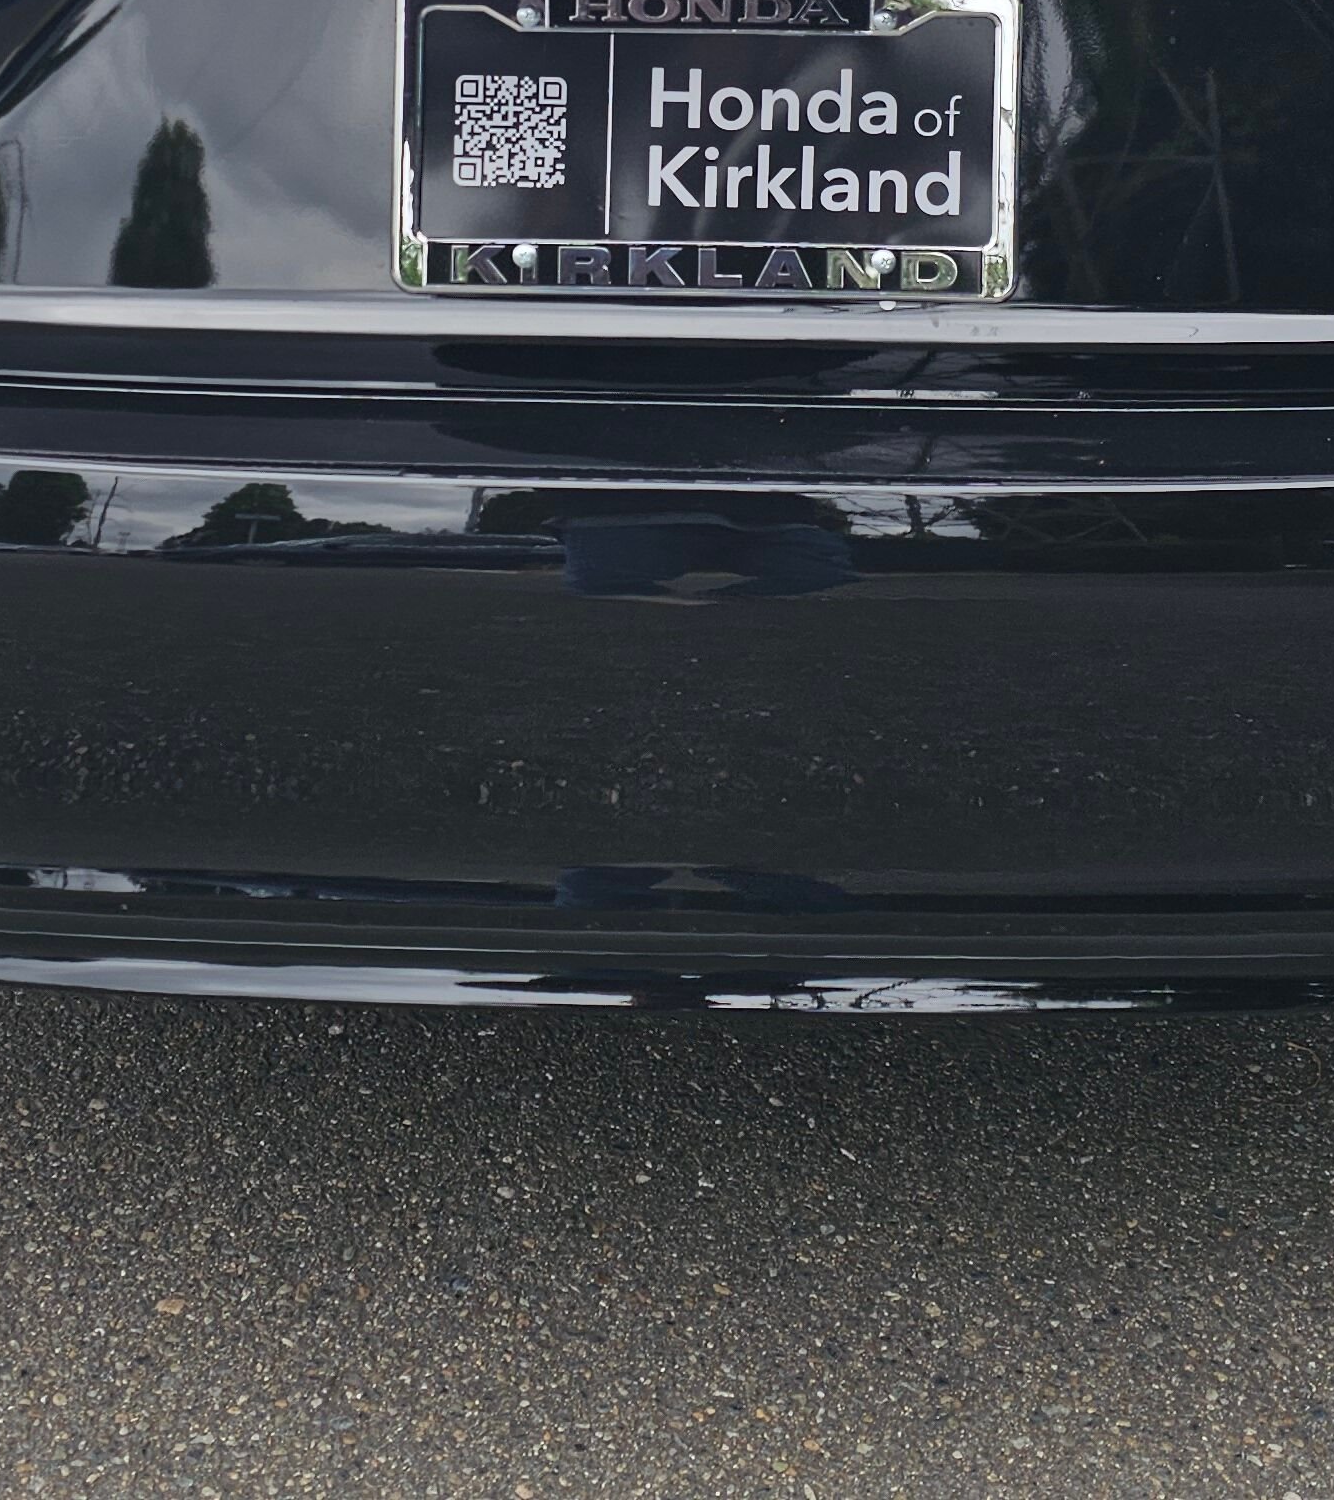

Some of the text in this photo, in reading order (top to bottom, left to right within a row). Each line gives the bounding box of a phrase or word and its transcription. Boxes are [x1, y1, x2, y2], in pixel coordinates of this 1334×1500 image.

[649, 67, 962, 137] Honda of
[647, 145, 961, 216] Kirkland
